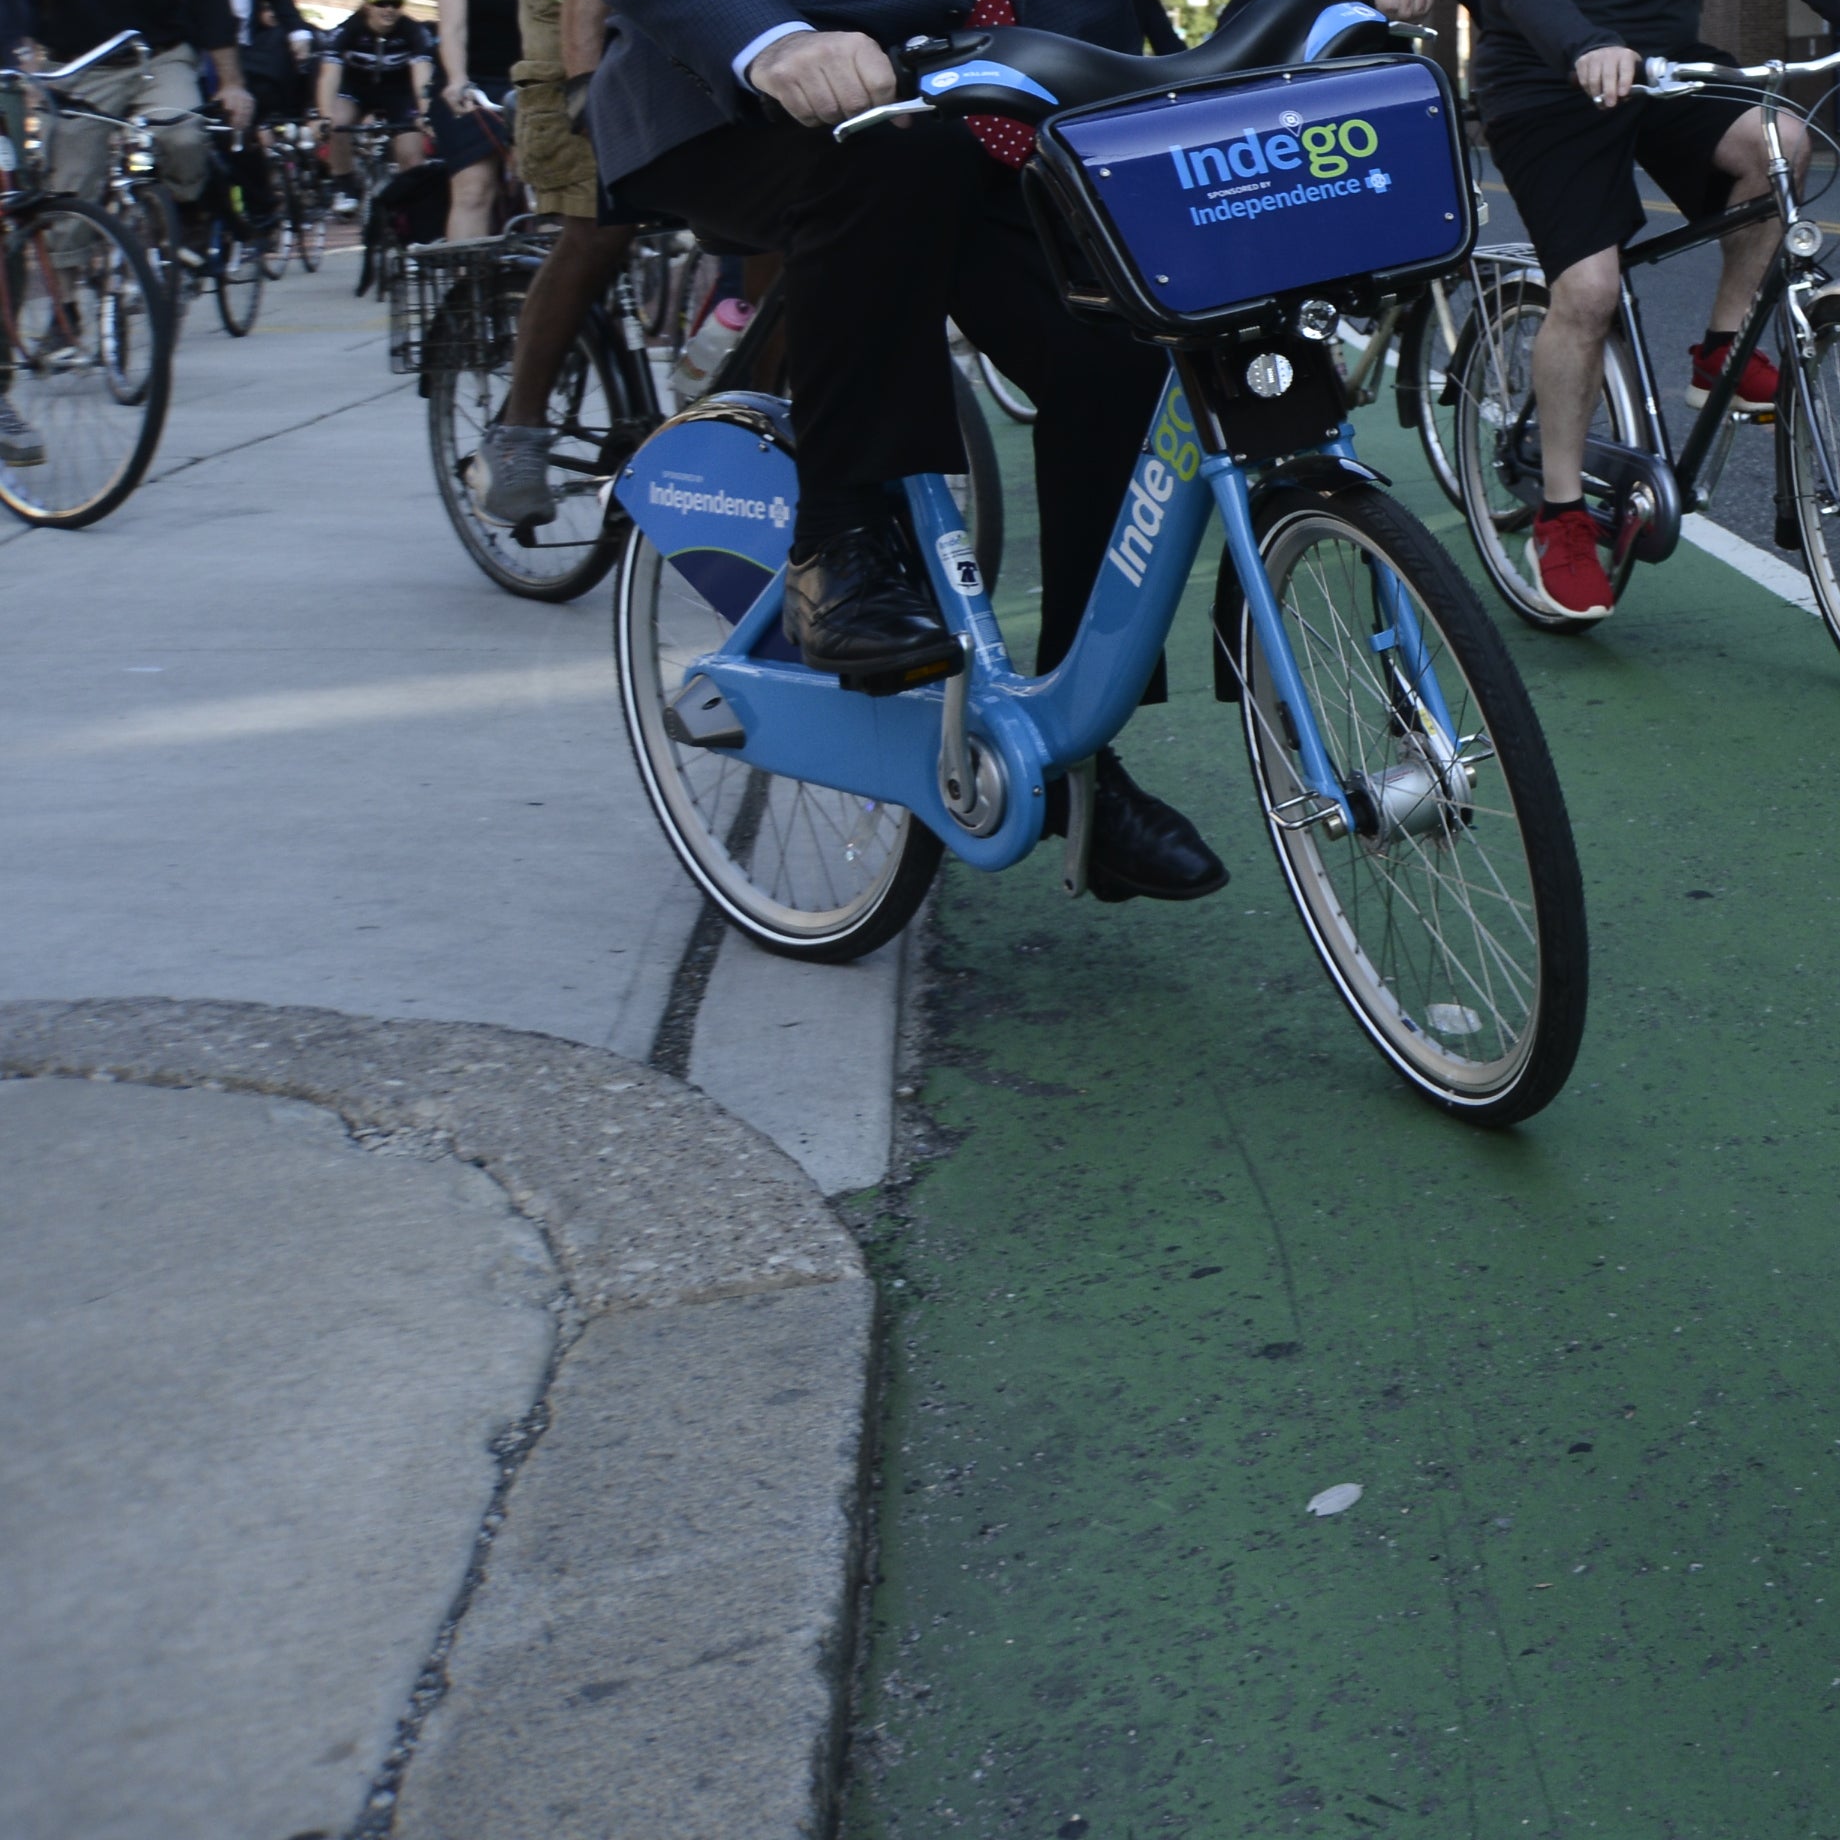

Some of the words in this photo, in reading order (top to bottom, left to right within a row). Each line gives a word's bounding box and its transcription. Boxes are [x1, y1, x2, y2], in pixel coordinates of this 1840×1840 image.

[1168, 117, 1379, 190] Indego
[1189, 178, 1361, 226] Independence
[1206, 182, 1259, 200] SPONSORED
[1260, 180, 1272, 190] BY
[649, 481, 766, 520] Independence
